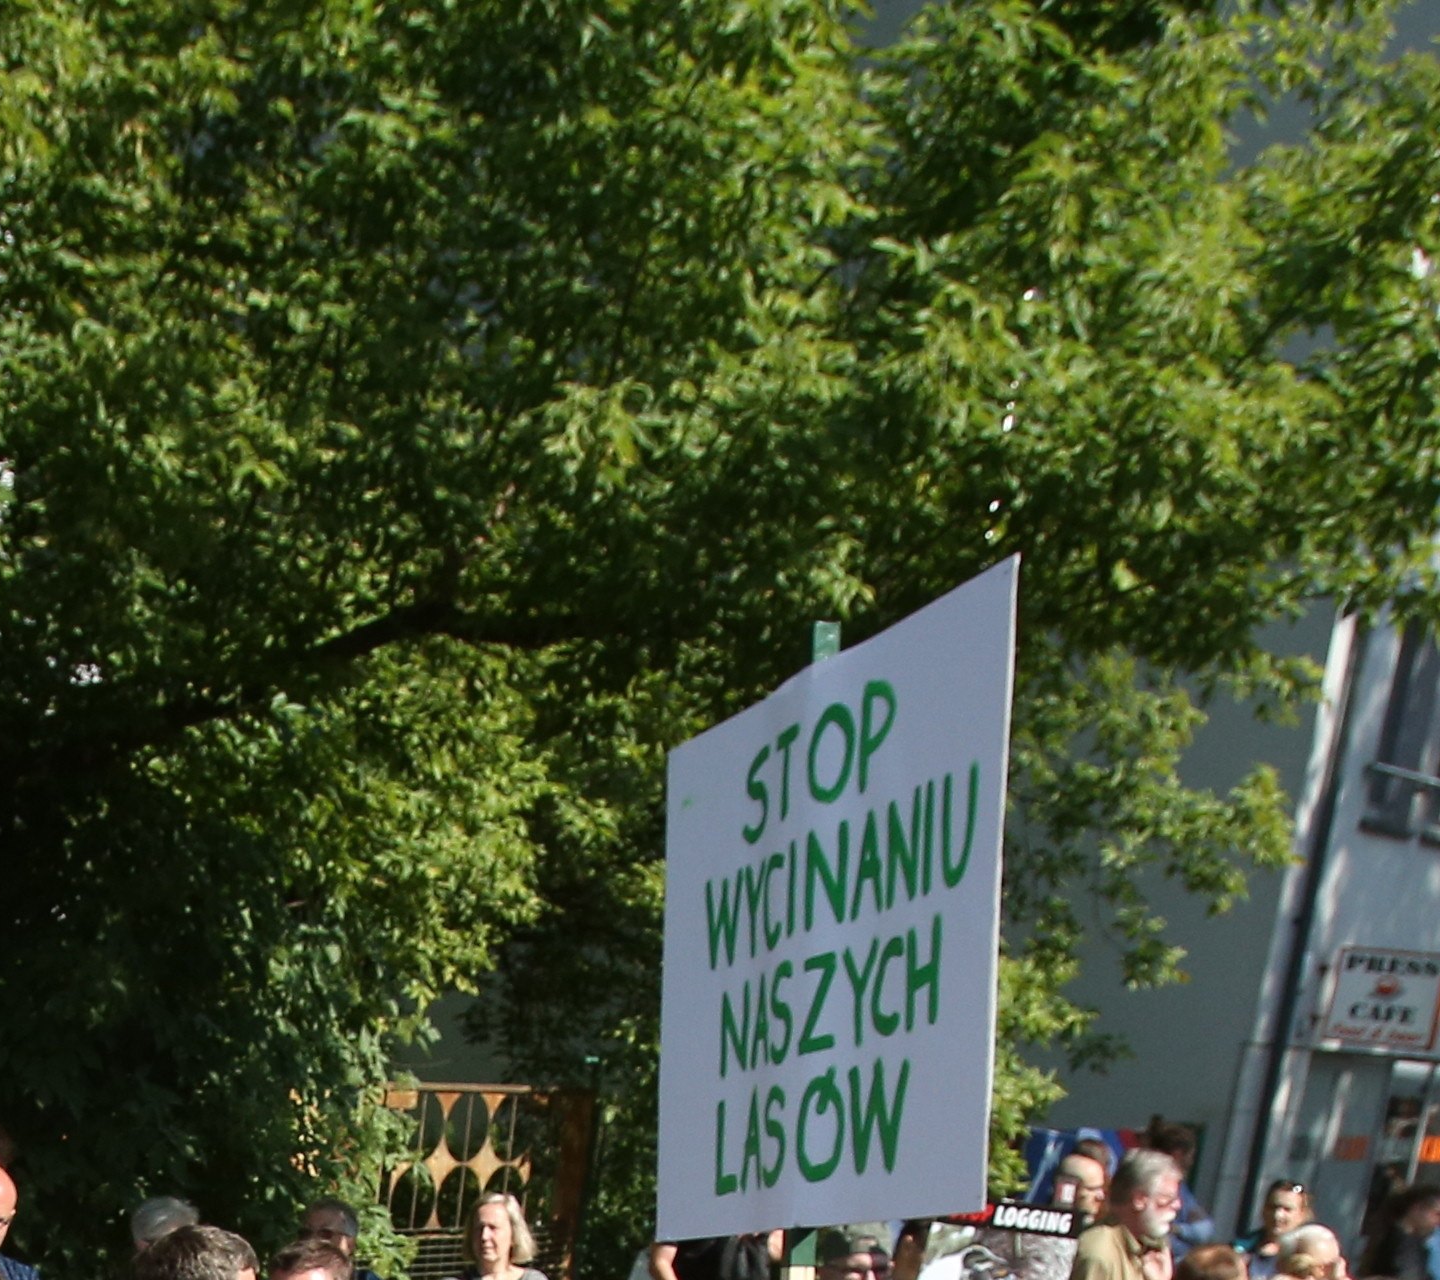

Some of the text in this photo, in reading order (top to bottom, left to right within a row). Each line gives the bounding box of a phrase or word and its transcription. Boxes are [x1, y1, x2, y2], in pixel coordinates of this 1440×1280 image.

[742, 679, 898, 845] STOP
[705, 760, 980, 971] WYCINANIU
[719, 913, 943, 1077] NASZYCH
[993, 1205, 1073, 1235] LOGGING
